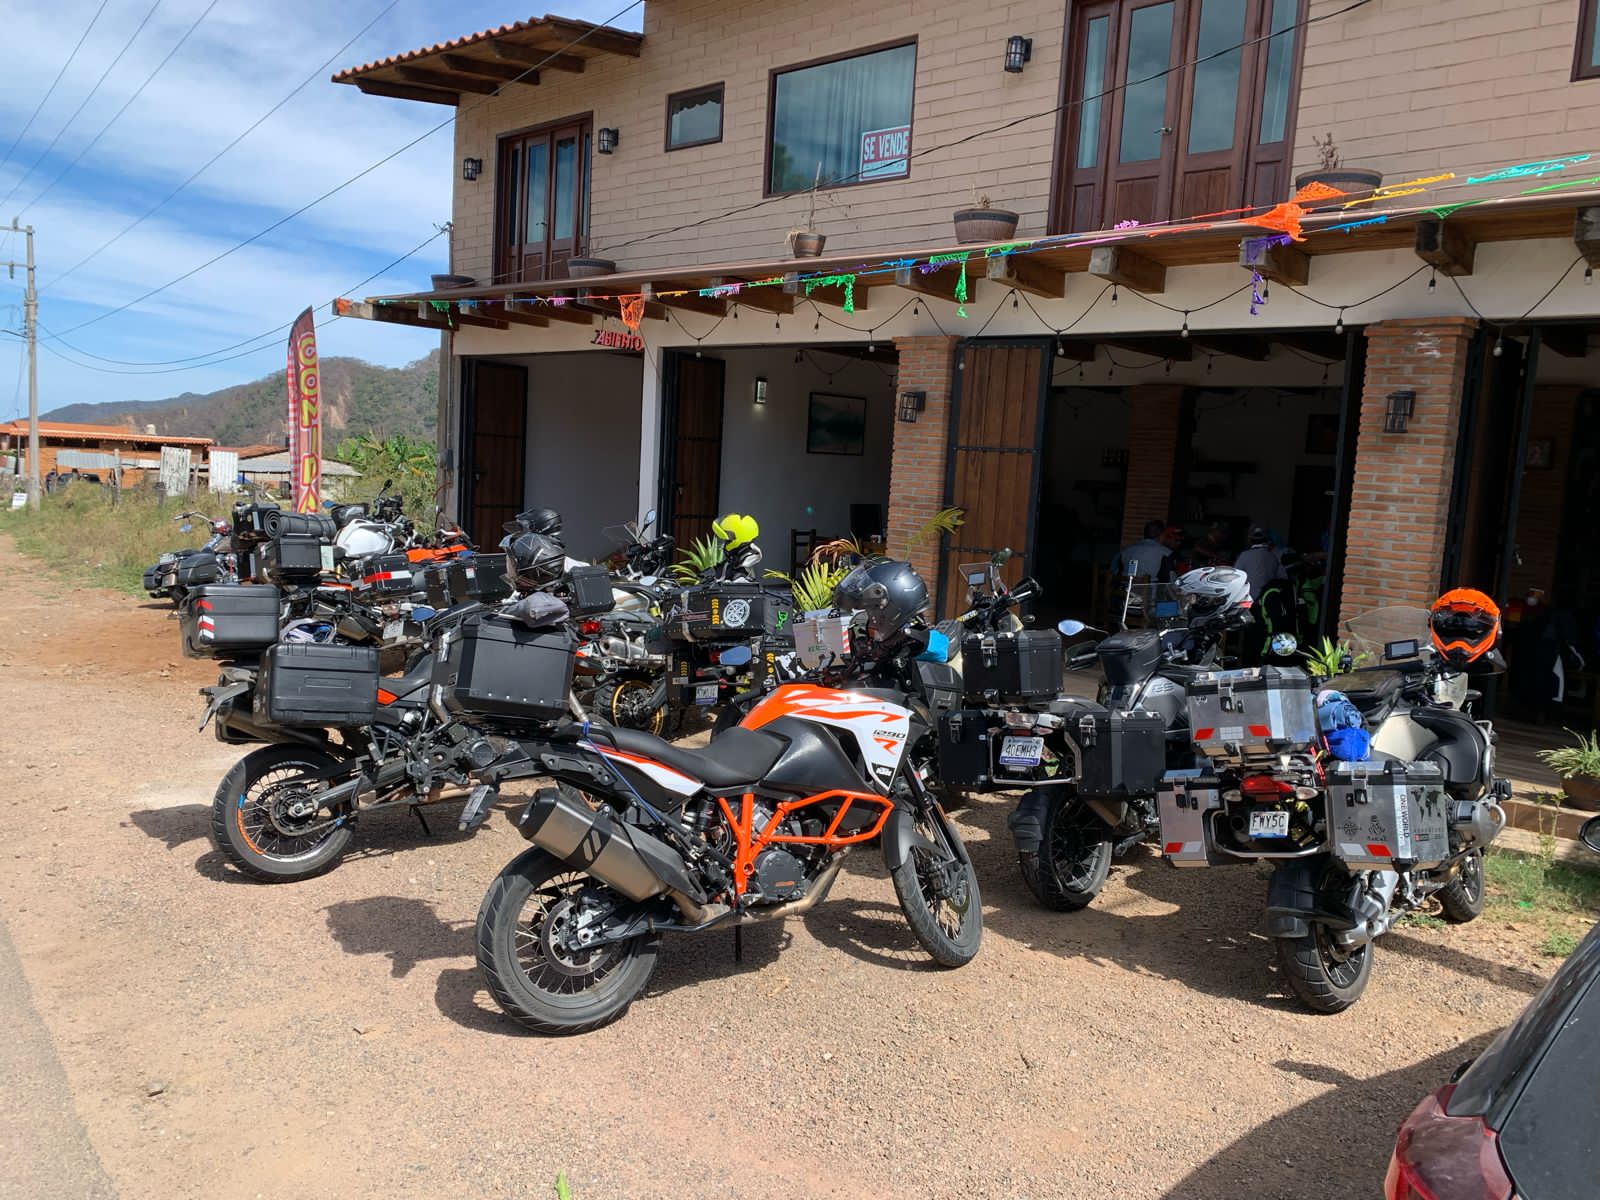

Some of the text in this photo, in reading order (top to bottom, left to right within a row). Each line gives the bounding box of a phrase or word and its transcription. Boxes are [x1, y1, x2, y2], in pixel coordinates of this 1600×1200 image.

[863, 130, 910, 161] SE VENDE
[872, 729, 907, 739] 1290
